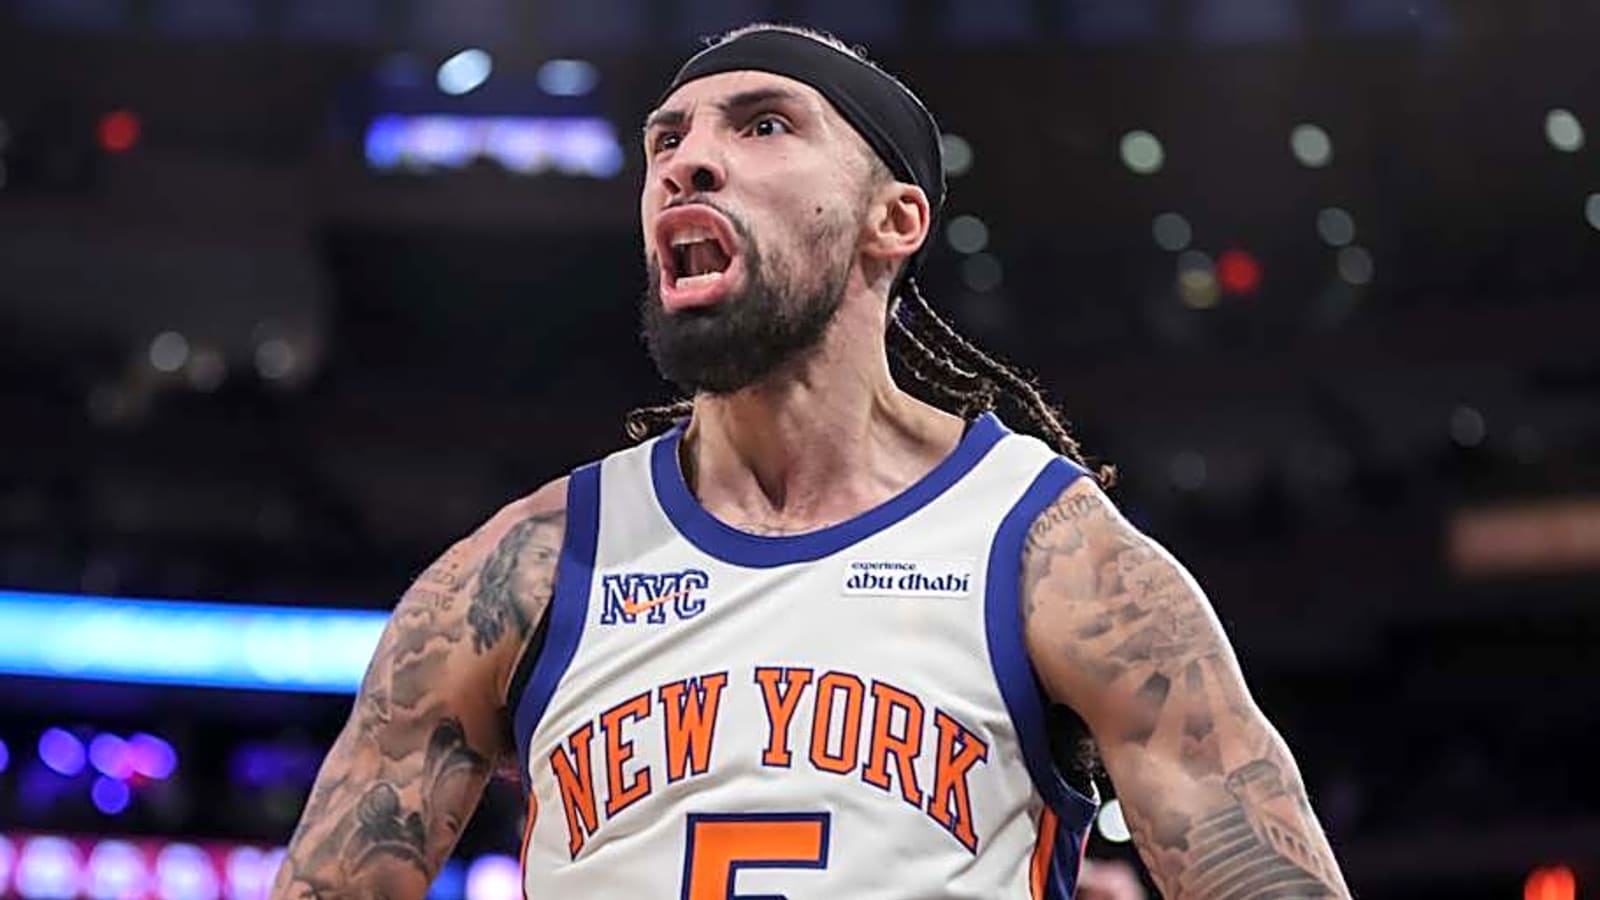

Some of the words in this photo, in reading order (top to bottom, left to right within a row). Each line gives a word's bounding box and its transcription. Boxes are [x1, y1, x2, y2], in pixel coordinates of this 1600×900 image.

[846, 572, 893, 589] abu
[898, 573, 970, 592] dhabi
[851, 561, 917, 574] experience
[600, 569, 709, 625] NYC
[549, 671, 729, 861] NEW
[754, 667, 989, 856] YORK
